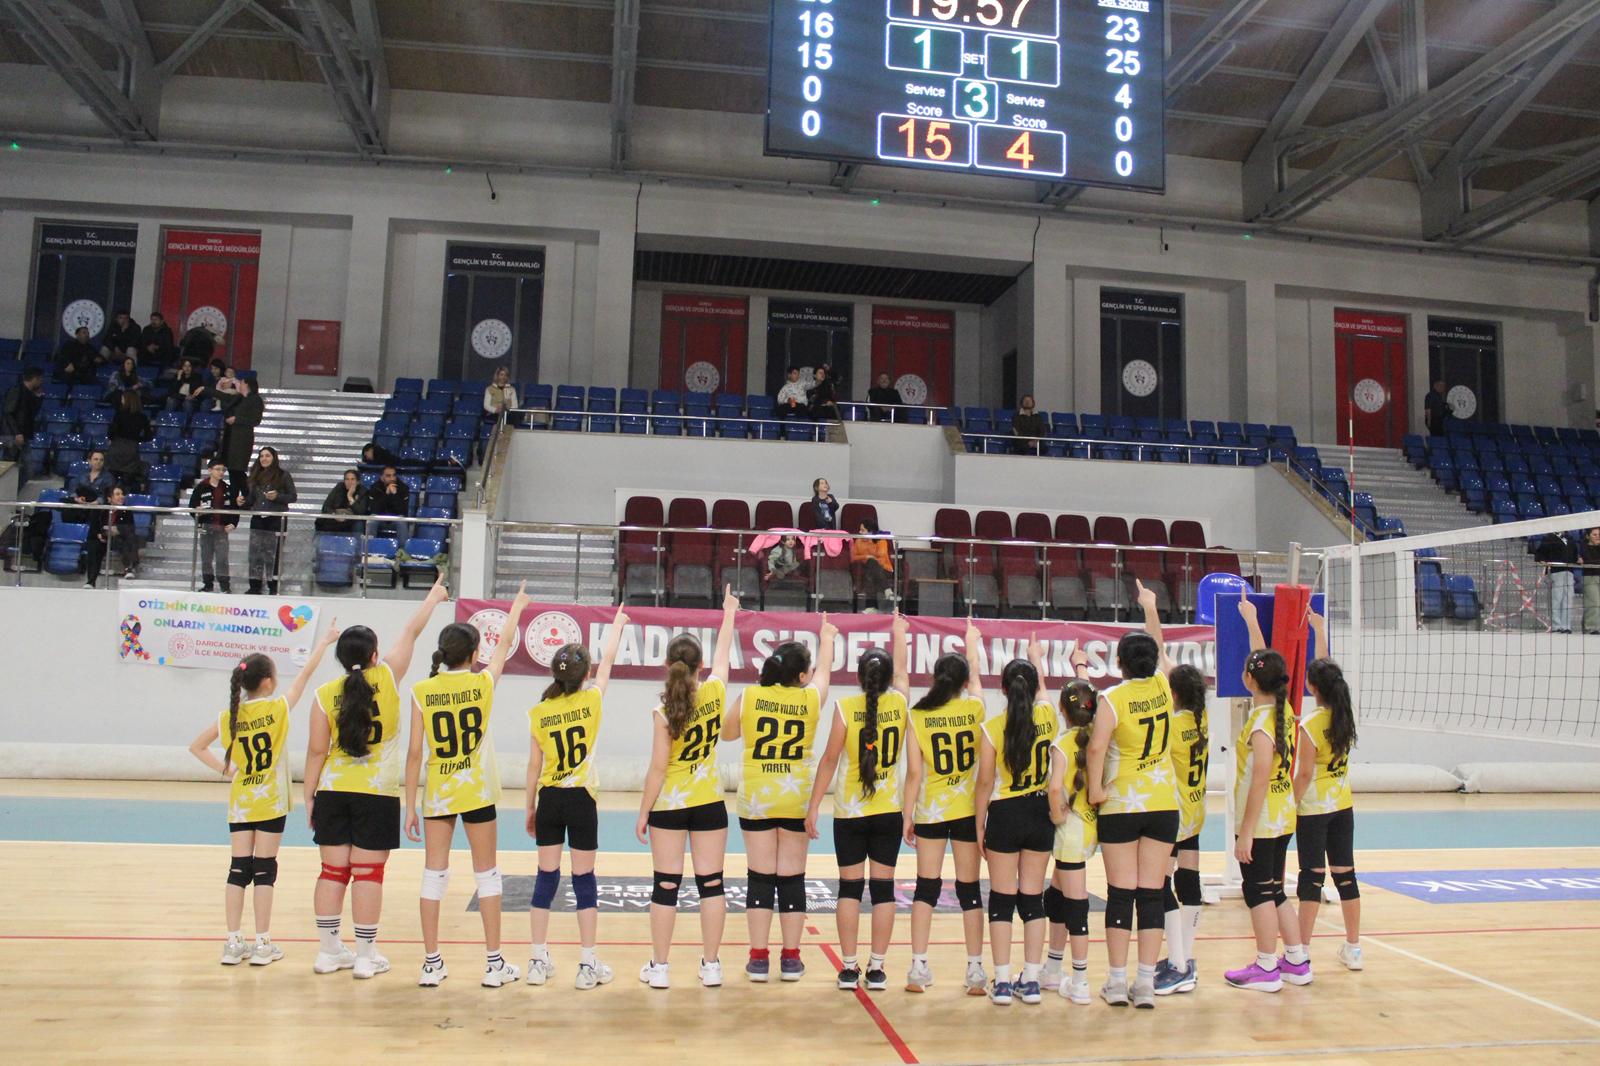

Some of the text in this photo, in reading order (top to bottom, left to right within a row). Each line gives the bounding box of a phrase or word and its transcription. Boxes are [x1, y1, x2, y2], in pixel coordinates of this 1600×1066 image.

[798, 10, 834, 38] 16
[1105, 15, 1140, 42] 23
[798, 42, 833, 70] 15
[914, 28, 932, 70] 1
[963, 53, 985, 65] SET
[1011, 39, 1029, 80] 1
[1105, 49, 1140, 75] 25
[803, 75, 822, 101] 0
[905, 83, 946, 98] Service
[964, 82, 989, 118] 3
[1006, 93, 1046, 108] Service
[1115, 84, 1132, 108] 4
[906, 102, 943, 117] Score
[1012, 114, 1048, 129] Score
[802, 111, 820, 137] 0
[1115, 116, 1132, 142] 0
[898, 118, 952, 161] 15
[1006, 131, 1035, 169] 4
[1115, 151, 1132, 176] 0
[453, 258, 479, 266] GENÇLİK
[138, 599, 188, 611] OTİZMİN
[153, 617, 283, 638] ONLARIN YANINDAYIZ!
[196, 639, 225, 648] DARICA
[225, 641, 256, 651] GENÇLİK
[269, 646, 290, 654] SPOR
[213, 650, 247, 660] MÜDÜRL
[752, 629, 890, 675] ŞDDET
[426, 688, 483, 706] DARICA YILDIZ SK
[755, 698, 809, 716] DARICA YILDIZ SK
[266, 714, 275, 726] SK
[540, 707, 592, 728] DARICA YILDIZ SK
[893, 709, 901, 720] SK
[925, 714, 976, 728] DARICA YILDIZ SK
[432, 706, 483, 759] 98
[679, 714, 720, 761] 25
[752, 716, 805, 760] 22
[1138, 711, 1169, 760] 77
[238, 732, 272, 775] 18
[549, 726, 587, 772] 16
[931, 730, 975, 775] 66
[761, 763, 792, 773] YAREN
[1188, 741, 1208, 787] 5
